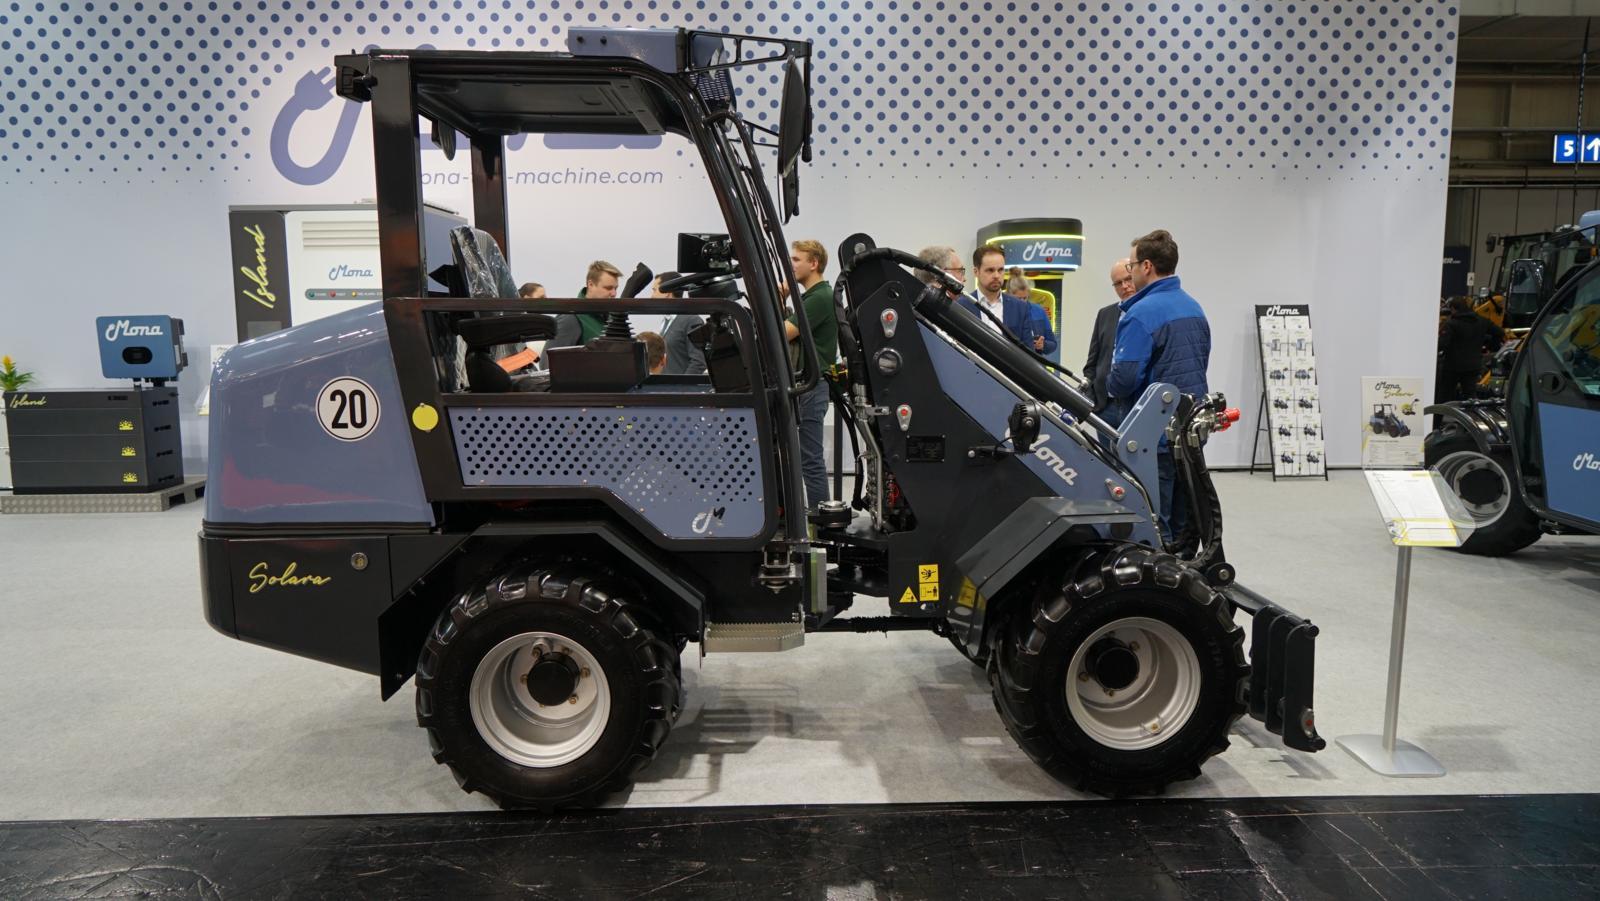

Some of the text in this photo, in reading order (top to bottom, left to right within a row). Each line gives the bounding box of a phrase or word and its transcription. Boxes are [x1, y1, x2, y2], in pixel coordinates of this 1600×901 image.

[1563, 140, 1574, 157] 5
[1022, 241, 1073, 262] Mona
[240, 224, 277, 309] Island
[328, 264, 374, 281] Mona
[1266, 305, 1300, 318] Mona
[105, 319, 164, 342] Mona
[1374, 381, 1401, 391] Mona
[9, 393, 48, 409] Island
[329, 389, 368, 429] 20
[1573, 452, 1600, 471] Mo
[248, 561, 332, 593] Solara
